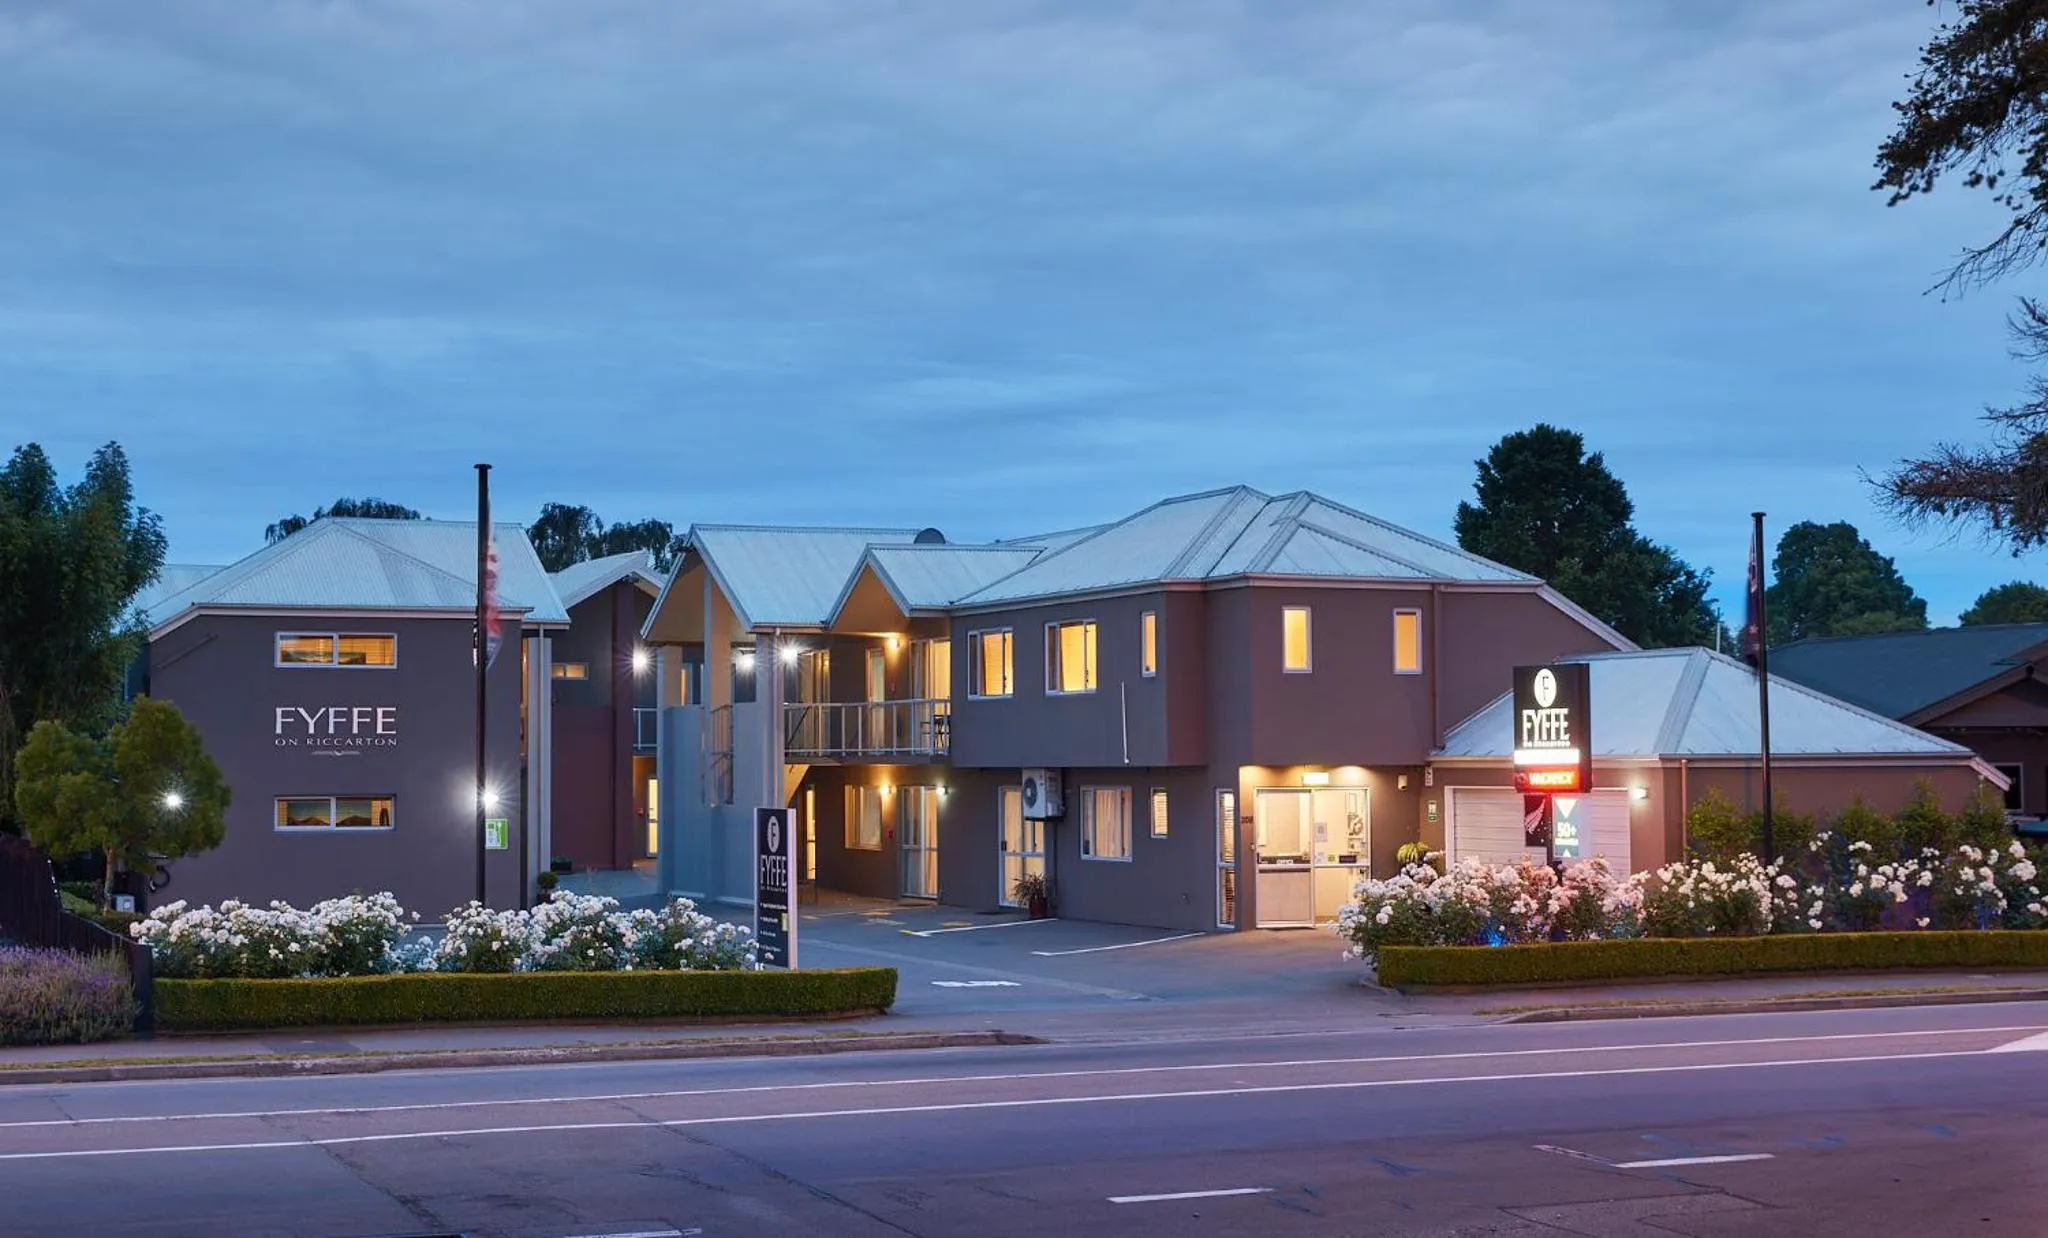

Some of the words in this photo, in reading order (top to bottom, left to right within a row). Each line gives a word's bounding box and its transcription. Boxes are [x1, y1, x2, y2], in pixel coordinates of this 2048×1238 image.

[275, 707, 397, 734] FYFFE
[1522, 708, 1570, 741] FYFFE
[275, 738, 298, 746] ON
[306, 738, 397, 746] RICCARTON
[760, 854, 787, 887] FYFFE
